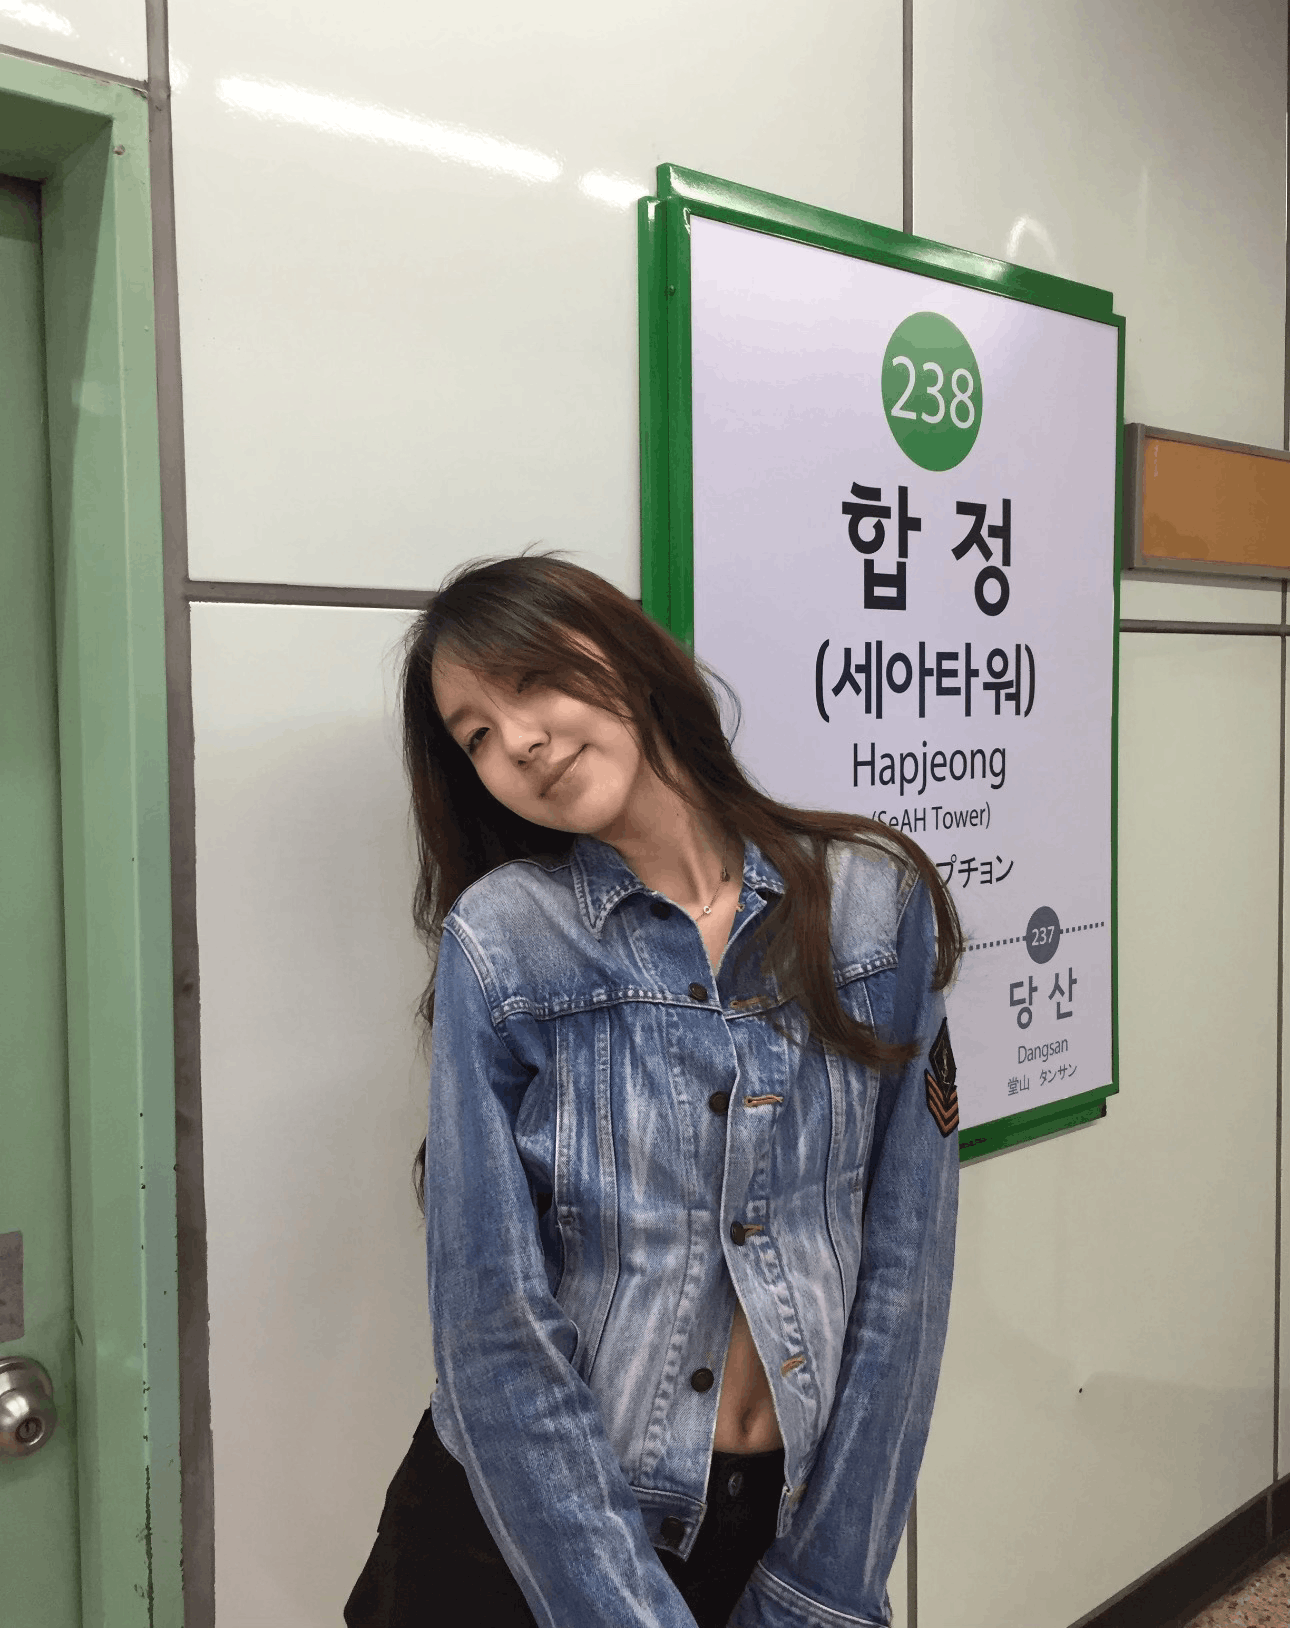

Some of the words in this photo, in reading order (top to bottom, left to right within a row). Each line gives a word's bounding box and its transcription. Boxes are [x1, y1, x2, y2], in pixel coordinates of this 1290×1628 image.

[890, 355, 976, 429] 238
[815, 639, 1036, 723] (세아타워)
[852, 740, 1007, 796] Hapjeong
[931, 801, 991, 830] Tower)
[1031, 925, 1055, 947] 237
[1017, 1038, 1068, 1064] Dangsan
[1007, 1074, 1030, 1096] 堂山
[1039, 1063, 1078, 1087] タンサン
